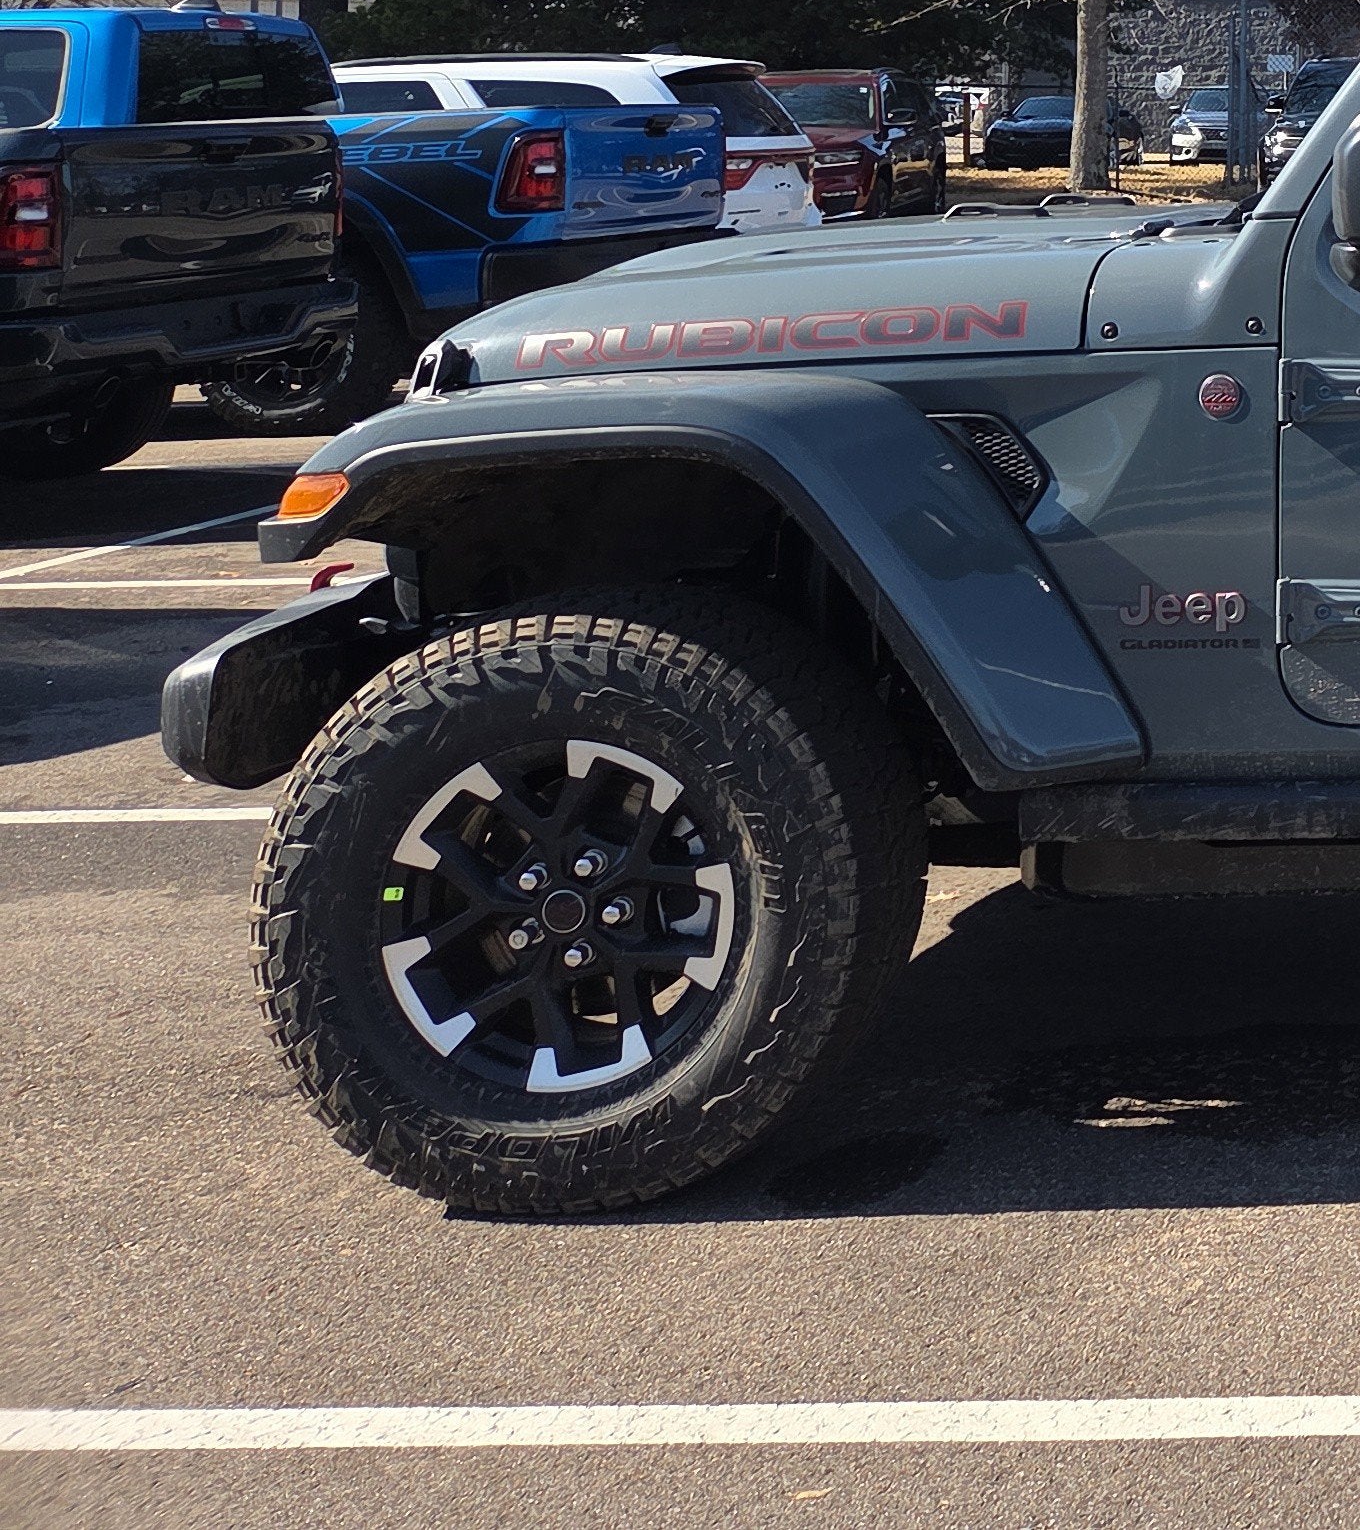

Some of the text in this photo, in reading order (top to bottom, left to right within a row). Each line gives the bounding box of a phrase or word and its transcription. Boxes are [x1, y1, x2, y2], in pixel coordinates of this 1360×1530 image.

[341, 141, 483, 166] EBEL
[159, 184, 289, 216] RAM
[514, 300, 1030, 370] RUBICON
[1119, 584, 1247, 633] Jeep
[1119, 637, 1239, 651] GLADIATOR
